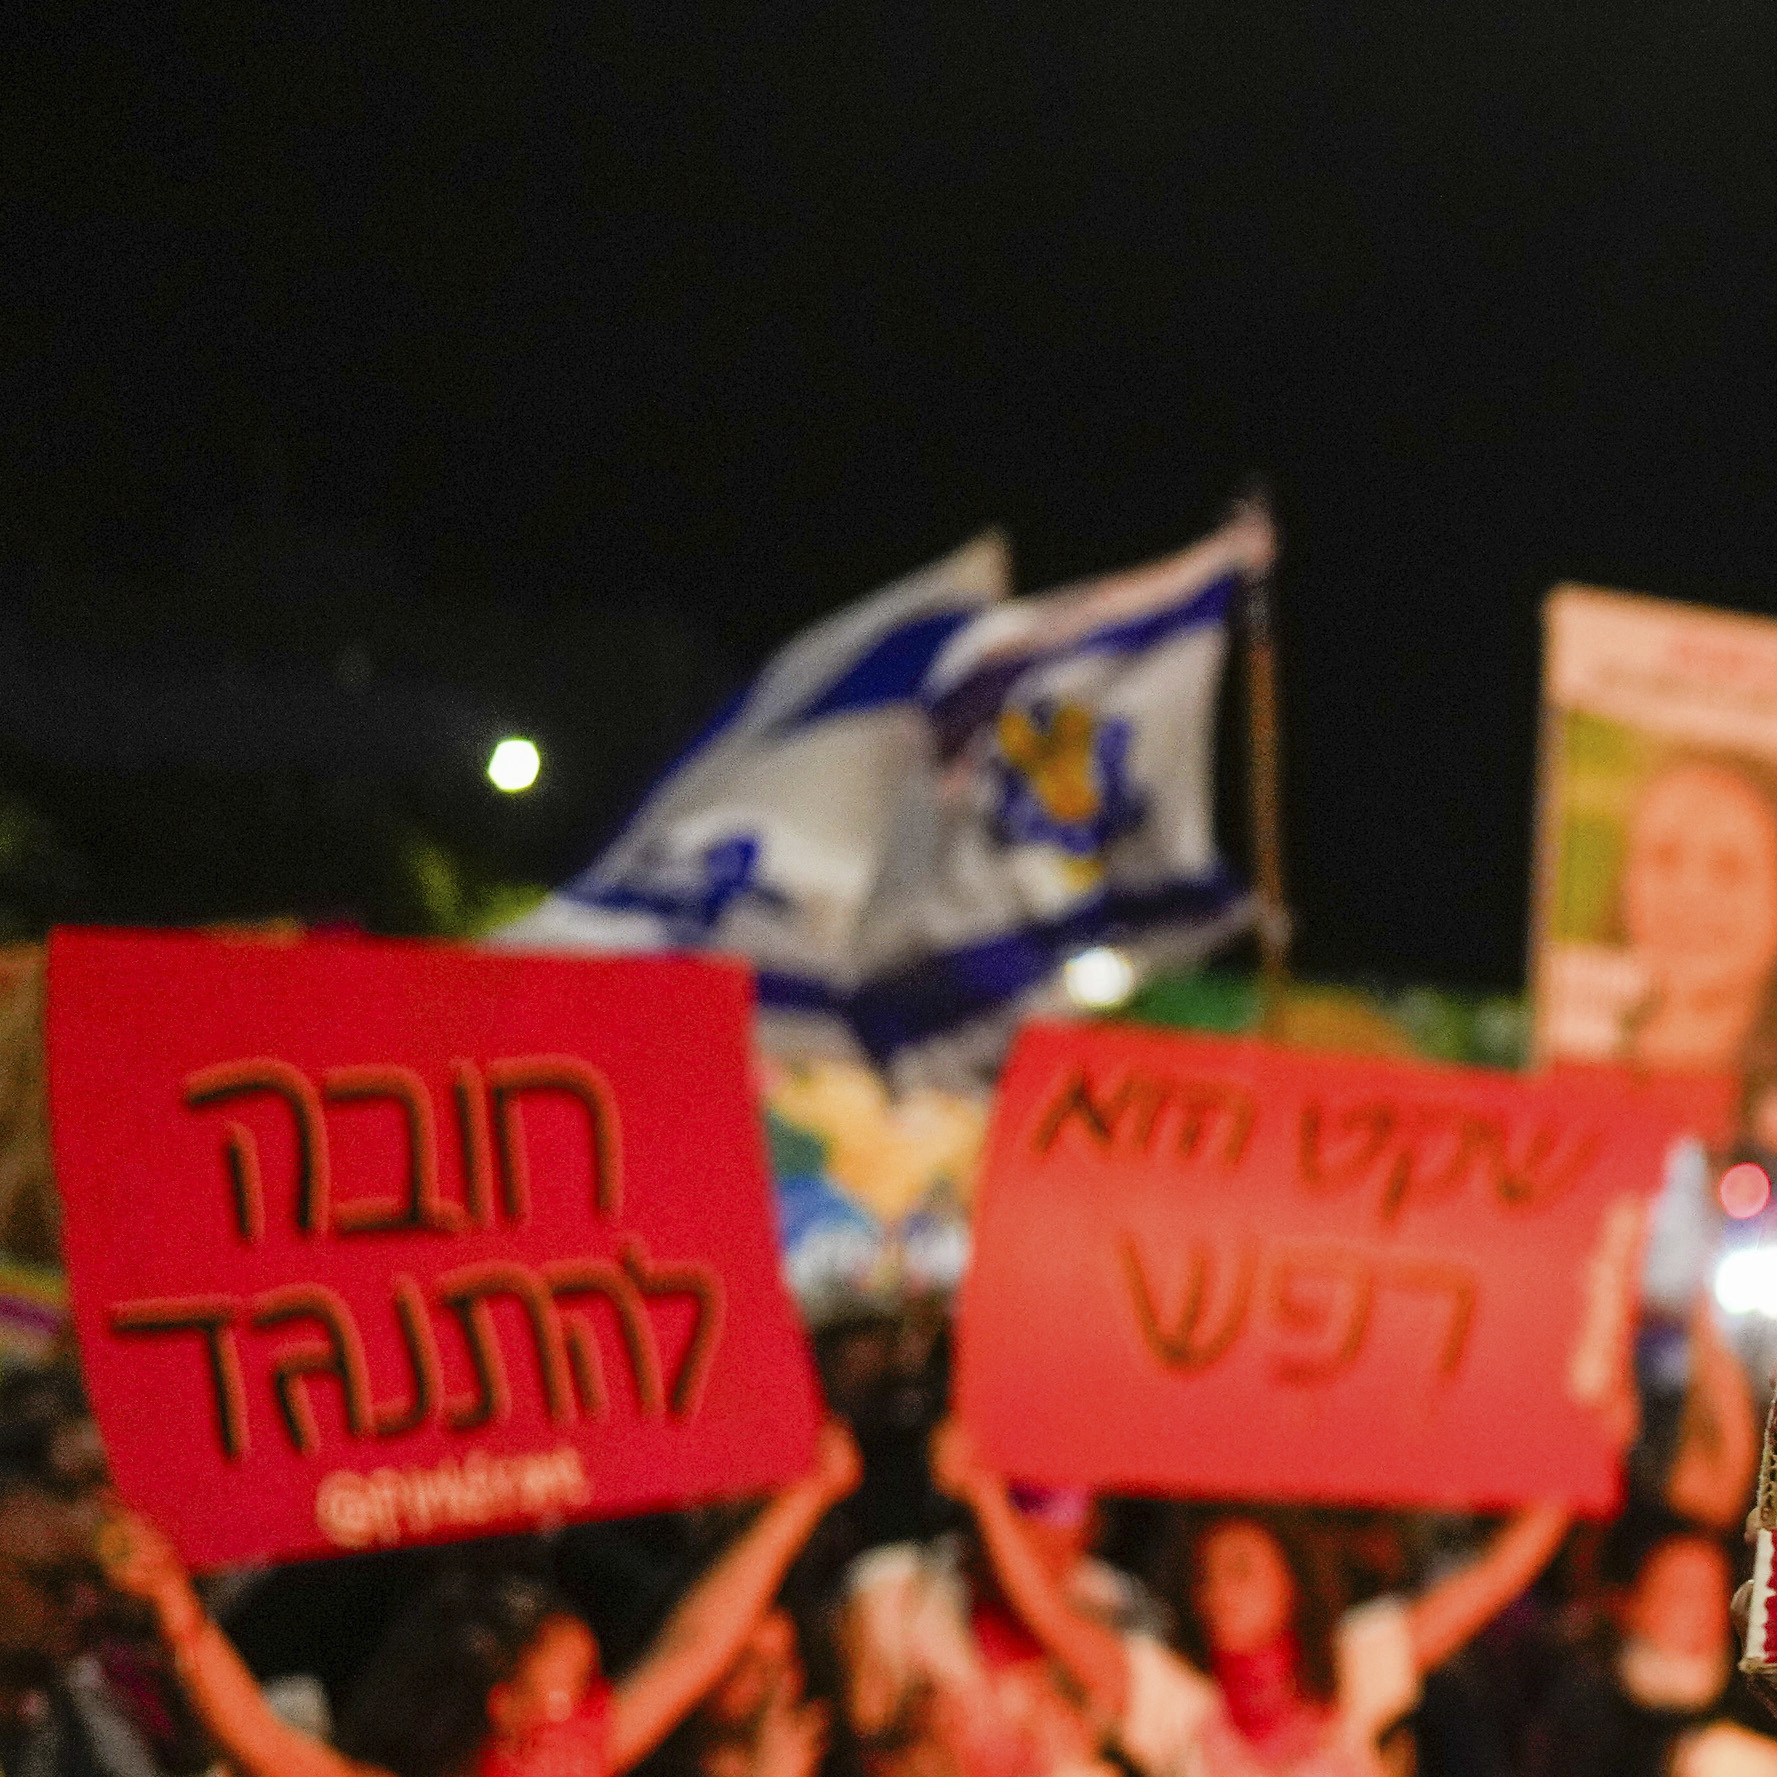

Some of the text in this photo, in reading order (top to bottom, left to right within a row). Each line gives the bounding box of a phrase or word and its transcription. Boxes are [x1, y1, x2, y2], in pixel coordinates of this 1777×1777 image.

[184, 1056, 624, 1242] חובה
[1297, 1098, 1600, 1234] שקט
[106, 1234, 727, 1461] להתנגד
[1116, 1229, 1480, 1390] רפש
